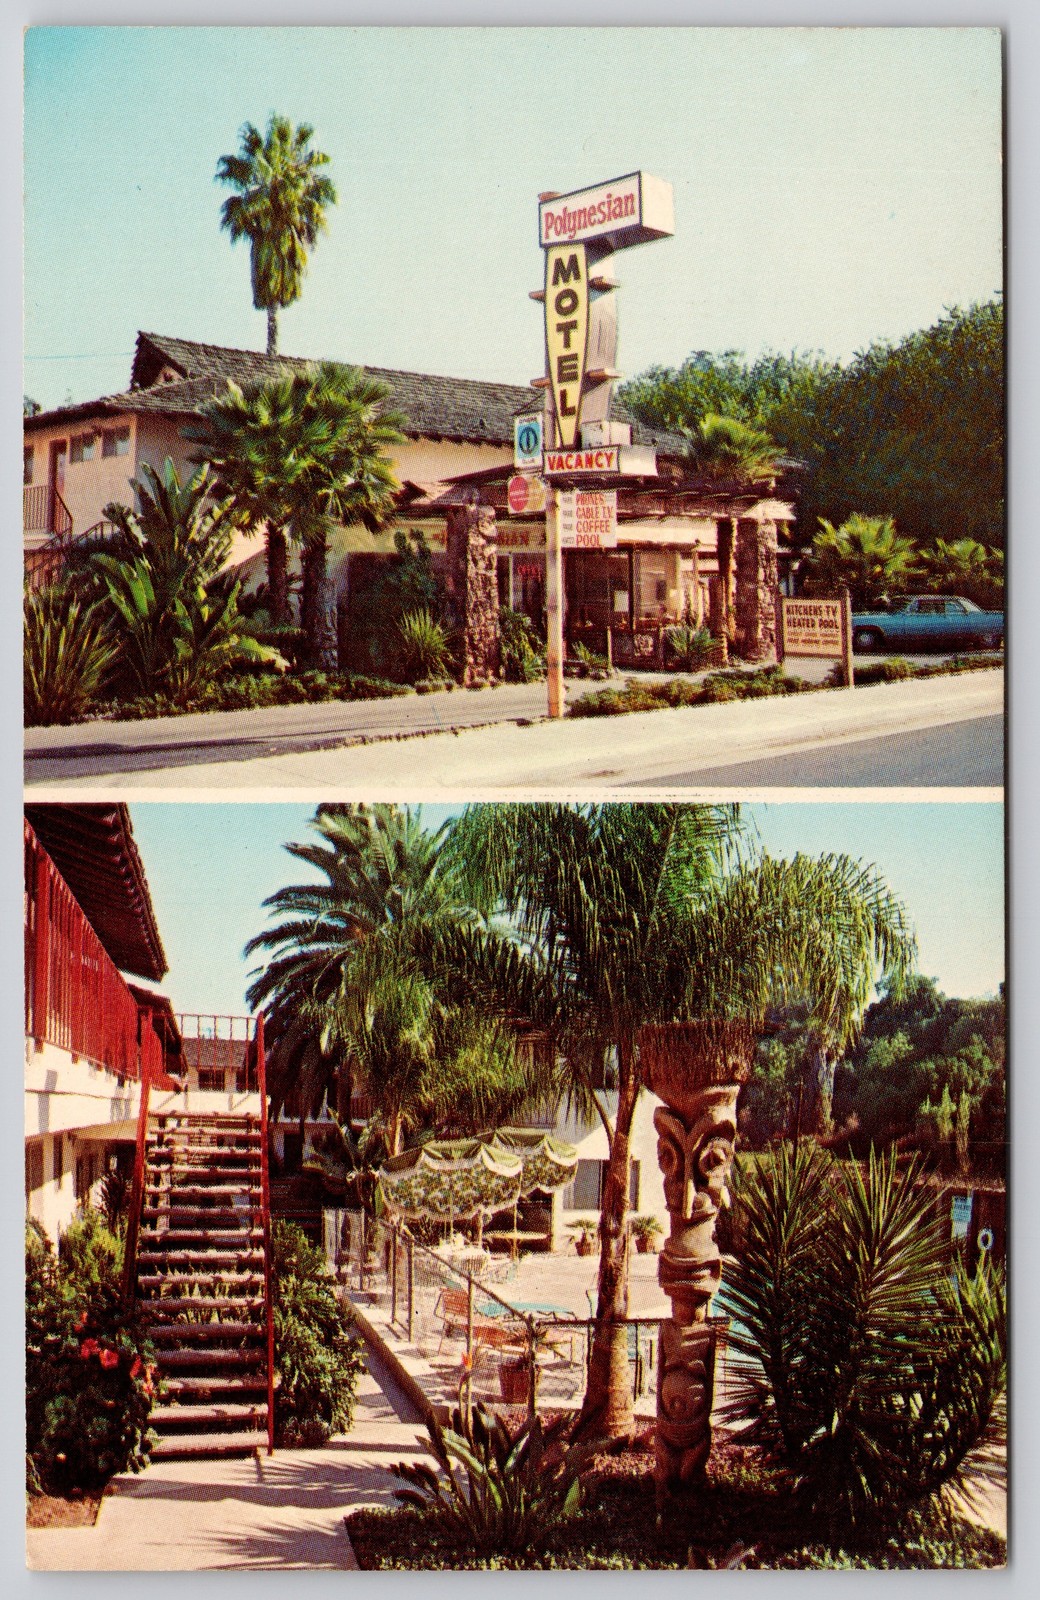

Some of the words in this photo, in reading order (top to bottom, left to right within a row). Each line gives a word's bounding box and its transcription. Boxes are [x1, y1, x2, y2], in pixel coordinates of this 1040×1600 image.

[544, 192, 635, 240] Polynesian
[552, 253, 581, 417] MOTEL
[547, 451, 614, 471] VACANCY
[575, 506, 600, 519] CABLE
[575, 520, 610, 533] COFFEE
[575, 534, 601, 547] POOL
[786, 604, 822, 616] KITCHENS
[818, 618, 839, 629] POOL
